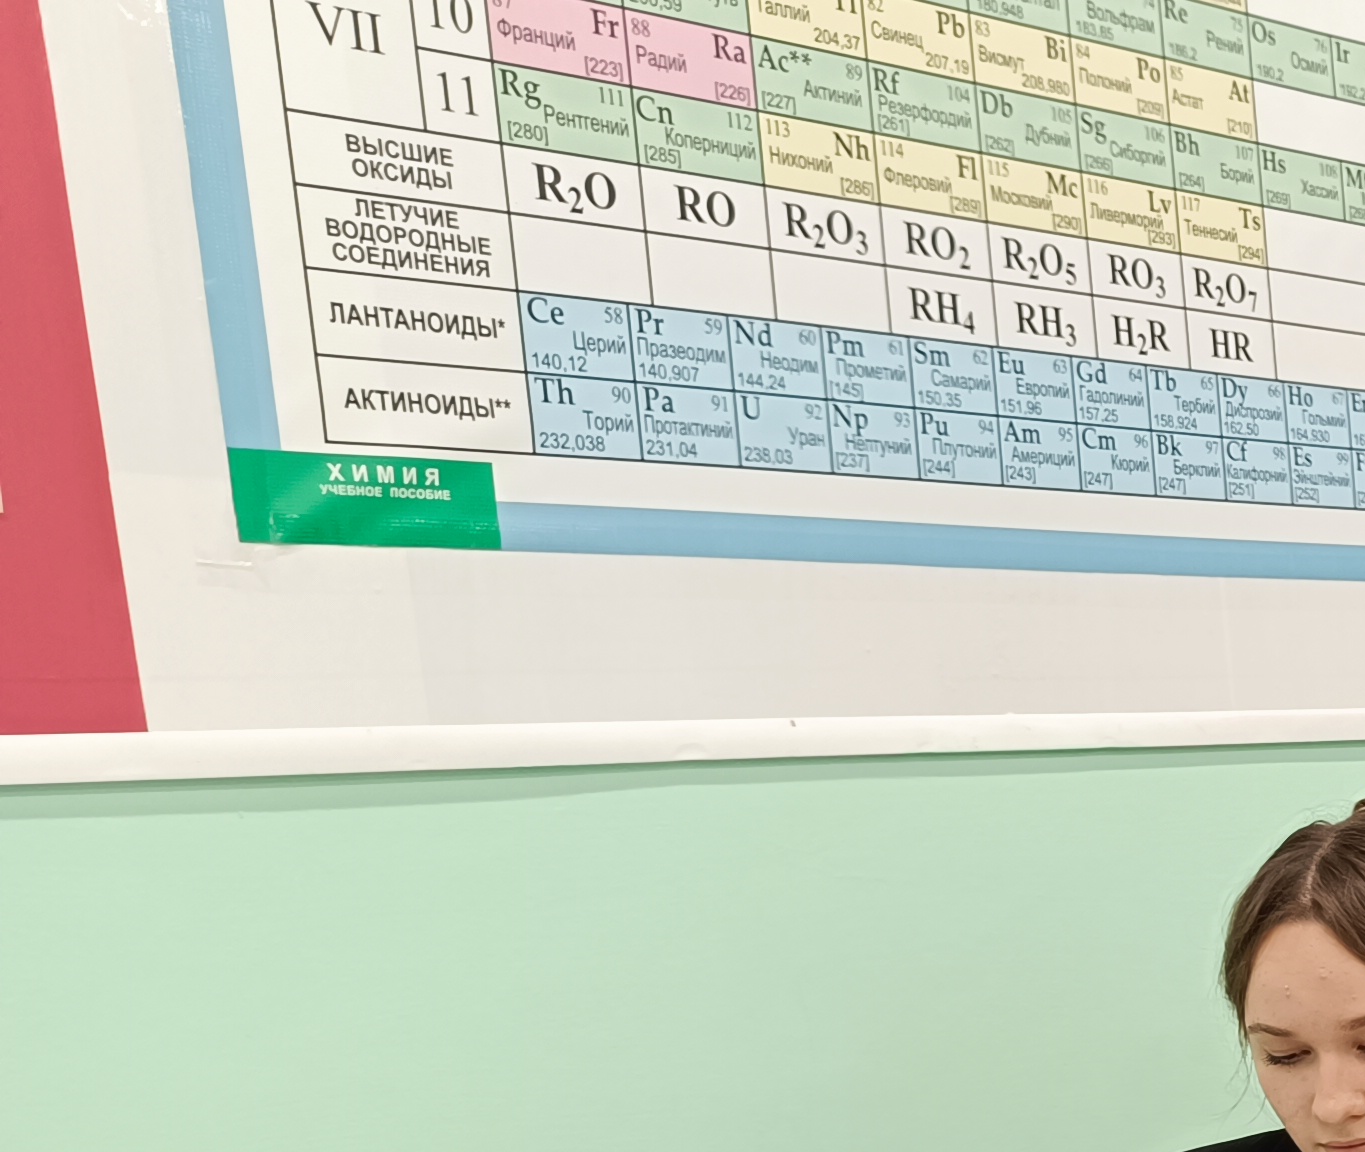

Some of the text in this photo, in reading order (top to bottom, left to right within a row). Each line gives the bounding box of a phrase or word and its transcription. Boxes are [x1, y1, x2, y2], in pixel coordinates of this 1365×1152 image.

[308, 1, 386, 55] VII
[431, 0, 474, 34] 10
[590, 8, 620, 39] Fr
[631, 18, 651, 37] 88
[935, 10, 965, 39] Pb
[497, 18, 576, 51] Франций
[813, 27, 861, 51] 204,37
[871, 20, 925, 52] Свинец
[1251, 20, 1276, 47] Os
[635, 45, 688, 74] Радий
[711, 33, 747, 64] Ra
[1044, 35, 1068, 63] Bi
[584, 55, 624, 82] [223]
[845, 63, 863, 81] 89
[925, 52, 970, 76] 207,19
[1136, 57, 1161, 84] Po
[437, 71, 479, 117] 11
[498, 67, 542, 110] Rg
[713, 81, 750, 106] [226]
[803, 79, 863, 108] Актиний
[871, 66, 900, 96] Rf
[1021, 73, 1070, 97] 208,980
[1228, 79, 1250, 104] At
[598, 86, 625, 108] 111
[636, 94, 675, 126] Cn
[761, 90, 797, 116] [227]
[979, 89, 1014, 119] Db
[543, 103, 630, 138] Рентгений
[726, 111, 754, 132] 112
[877, 93, 973, 130] Резерфордий
[507, 120, 549, 147] [280]
[765, 117, 791, 138] 113
[1025, 122, 1073, 150] Дубний
[1080, 111, 1108, 146] Sg
[345, 132, 454, 168] ВЫСШИЕ
[643, 143, 682, 170] [285]
[664, 126, 757, 163] Коперниций
[832, 130, 872, 162] Nh
[1174, 130, 1201, 158] Bh
[351, 157, 453, 190] ОКСИДЫ
[768, 145, 834, 175] Нихоний
[955, 153, 979, 182] Fl
[1261, 149, 1287, 175] Hs
[839, 176, 875, 200] [286]
[883, 165, 953, 197] Флеровий
[1045, 169, 1079, 199] Mc
[673, 184, 737, 228] RO
[990, 184, 1054, 212] Московий
[1146, 189, 1173, 215] Lv
[354, 197, 460, 230] ЛЕТУЧИЕ
[1089, 202, 1165, 233] Ливерморий
[1238, 205, 1262, 232] Ts
[324, 217, 492, 257] ВОДОРОДНЫЕ
[331, 242, 491, 279] СОЕДИНЕНИЯ
[526, 296, 624, 326] Ce 58
[633, 307, 723, 337] Pr 59
[572, 329, 627, 358] Церий
[732, 319, 774, 349] Nd
[825, 330, 865, 358] Pm
[1208, 327, 1255, 363] HR
[531, 351, 588, 374] 140,12
[637, 336, 727, 365] Празеодим
[760, 350, 819, 375] Неодим
[914, 340, 951, 368] Sm
[996, 350, 1026, 377] Eu
[638, 362, 700, 383] 140,907
[737, 371, 787, 391] 144,24
[835, 357, 908, 384] Прометий
[930, 368, 992, 395] Самарий
[1076, 359, 1108, 385] Gd
[1150, 368, 1177, 393] Tb
[534, 376, 632, 406] Th 90
[642, 385, 729, 414] Pa 91
[917, 389, 962, 409] 150,35
[1015, 377, 1071, 401] Европий
[1079, 384, 1146, 409] Гадолиний
[1220, 376, 1248, 407] Dy
[1287, 384, 1314, 408] Ho
[740, 394, 761, 421] U
[1000, 397, 1043, 416] 151,96
[1078, 405, 1119, 423] 157,25
[1173, 394, 1217, 417] Тербий
[1225, 400, 1283, 423] Диспрозий
[581, 408, 635, 436] Торий
[643, 413, 734, 440] Протактиний
[832, 403, 869, 437] Np
[920, 411, 950, 437] Pu
[1003, 420, 1042, 445] Am
[538, 431, 606, 453] 232,038
[645, 438, 698, 459] 231,04
[787, 425, 826, 448] Уран
[931, 437, 998, 462] Плутоний
[1081, 426, 1117, 452] Cm
[1156, 434, 1183, 458] Bk
[743, 445, 794, 466] 238,03
[835, 451, 870, 473] [237]
[1011, 446, 1076, 470] Америций
[1110, 452, 1151, 476] Кюрий
[1226, 440, 1248, 463] Cf
[1292, 445, 1313, 468] Es
[325, 462, 441, 487] ХИМИЯ
[922, 457, 956, 479] [244]
[1005, 464, 1036, 485] [243]
[1083, 470, 1113, 491] [247]
[1173, 458, 1221, 479] Берклий
[319, 483, 452, 501] УЧЕБНОЕ ПОСОБИЕ
